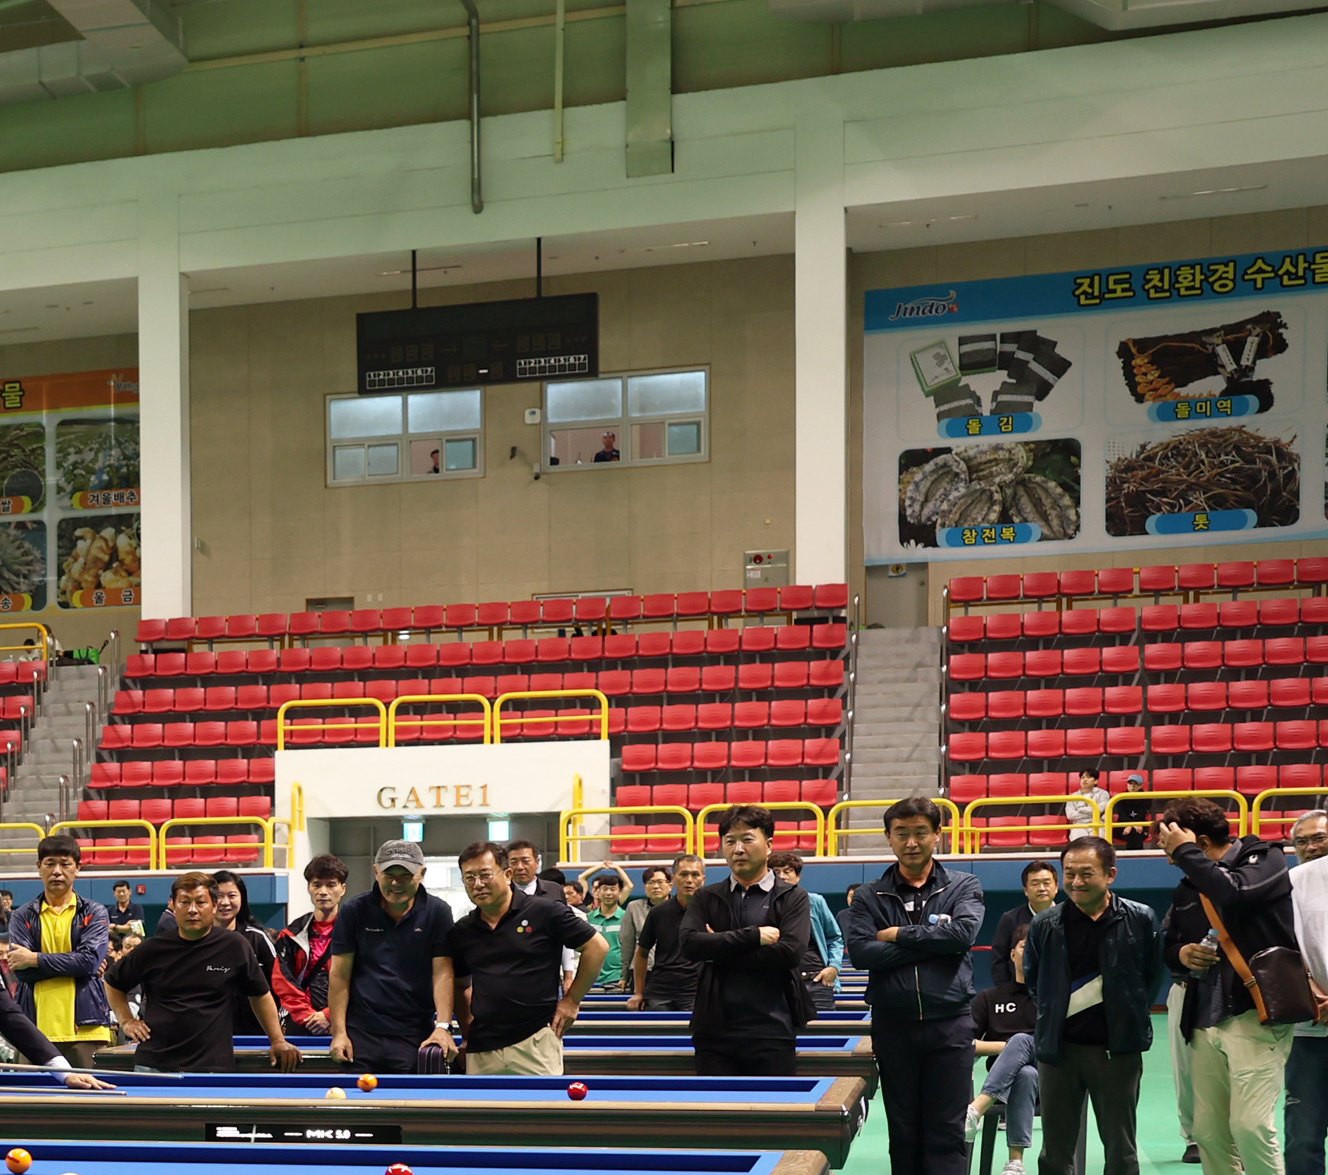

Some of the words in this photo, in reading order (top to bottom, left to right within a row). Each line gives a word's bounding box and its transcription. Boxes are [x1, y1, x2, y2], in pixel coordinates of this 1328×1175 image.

[1072, 271, 1135, 306] 진도
[1143, 261, 1238, 301] 친환경
[889, 297, 950, 321] Jindo
[1173, 398, 1234, 419] 돌미역
[88, 491, 138, 506] 겨울배추
[1192, 512, 1210, 531] 톳
[961, 525, 1017, 545] 참전복
[376, 783, 491, 810] GATE1
[994, 1002, 1016, 1014] HC
[306, 1129, 334, 1139] MK
[335, 1129, 351, 1140] 5.0
